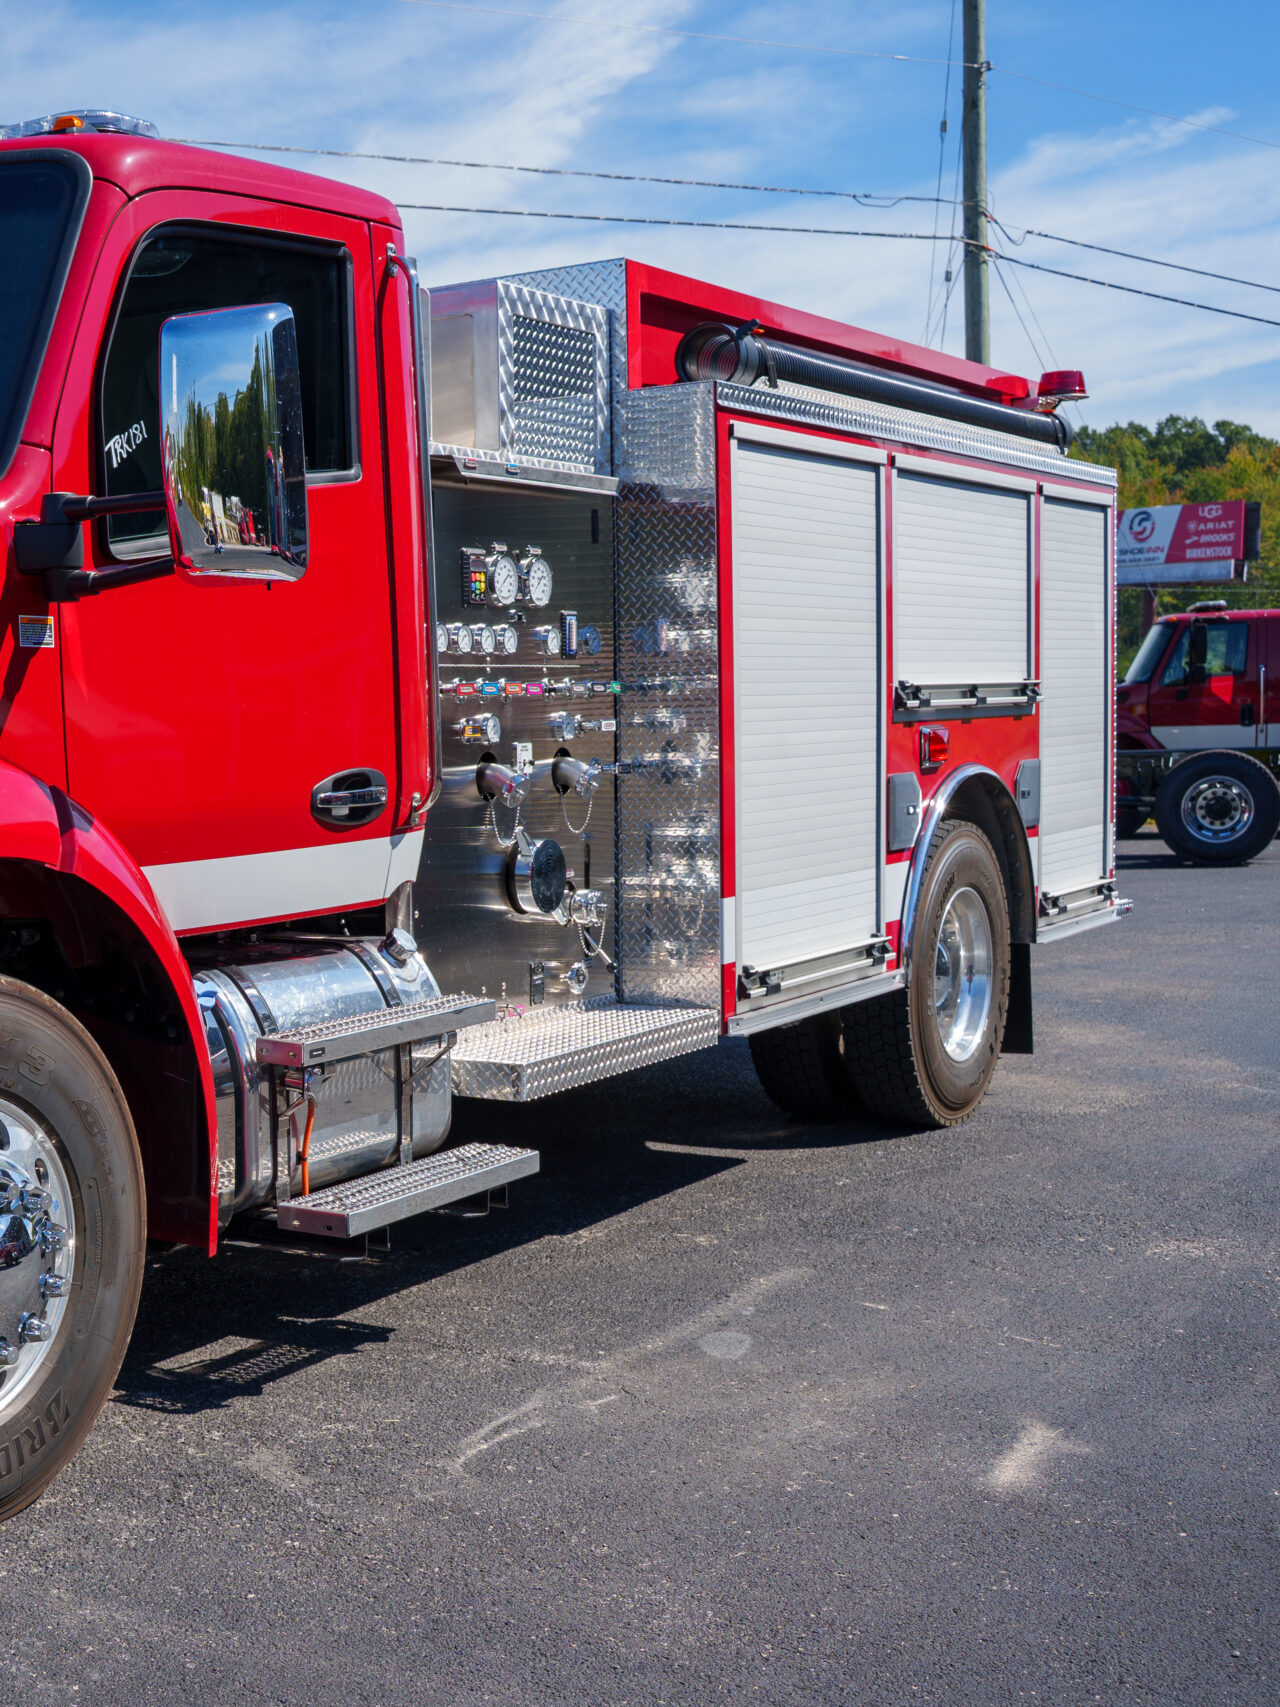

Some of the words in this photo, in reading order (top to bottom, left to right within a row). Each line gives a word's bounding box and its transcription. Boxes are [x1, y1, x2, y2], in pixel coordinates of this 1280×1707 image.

[105, 420, 147, 468] TRK181
[1199, 505, 1222, 518] UGG
[1198, 520, 1235, 531] ARIAT
[1200, 533, 1235, 543] BROOKS
